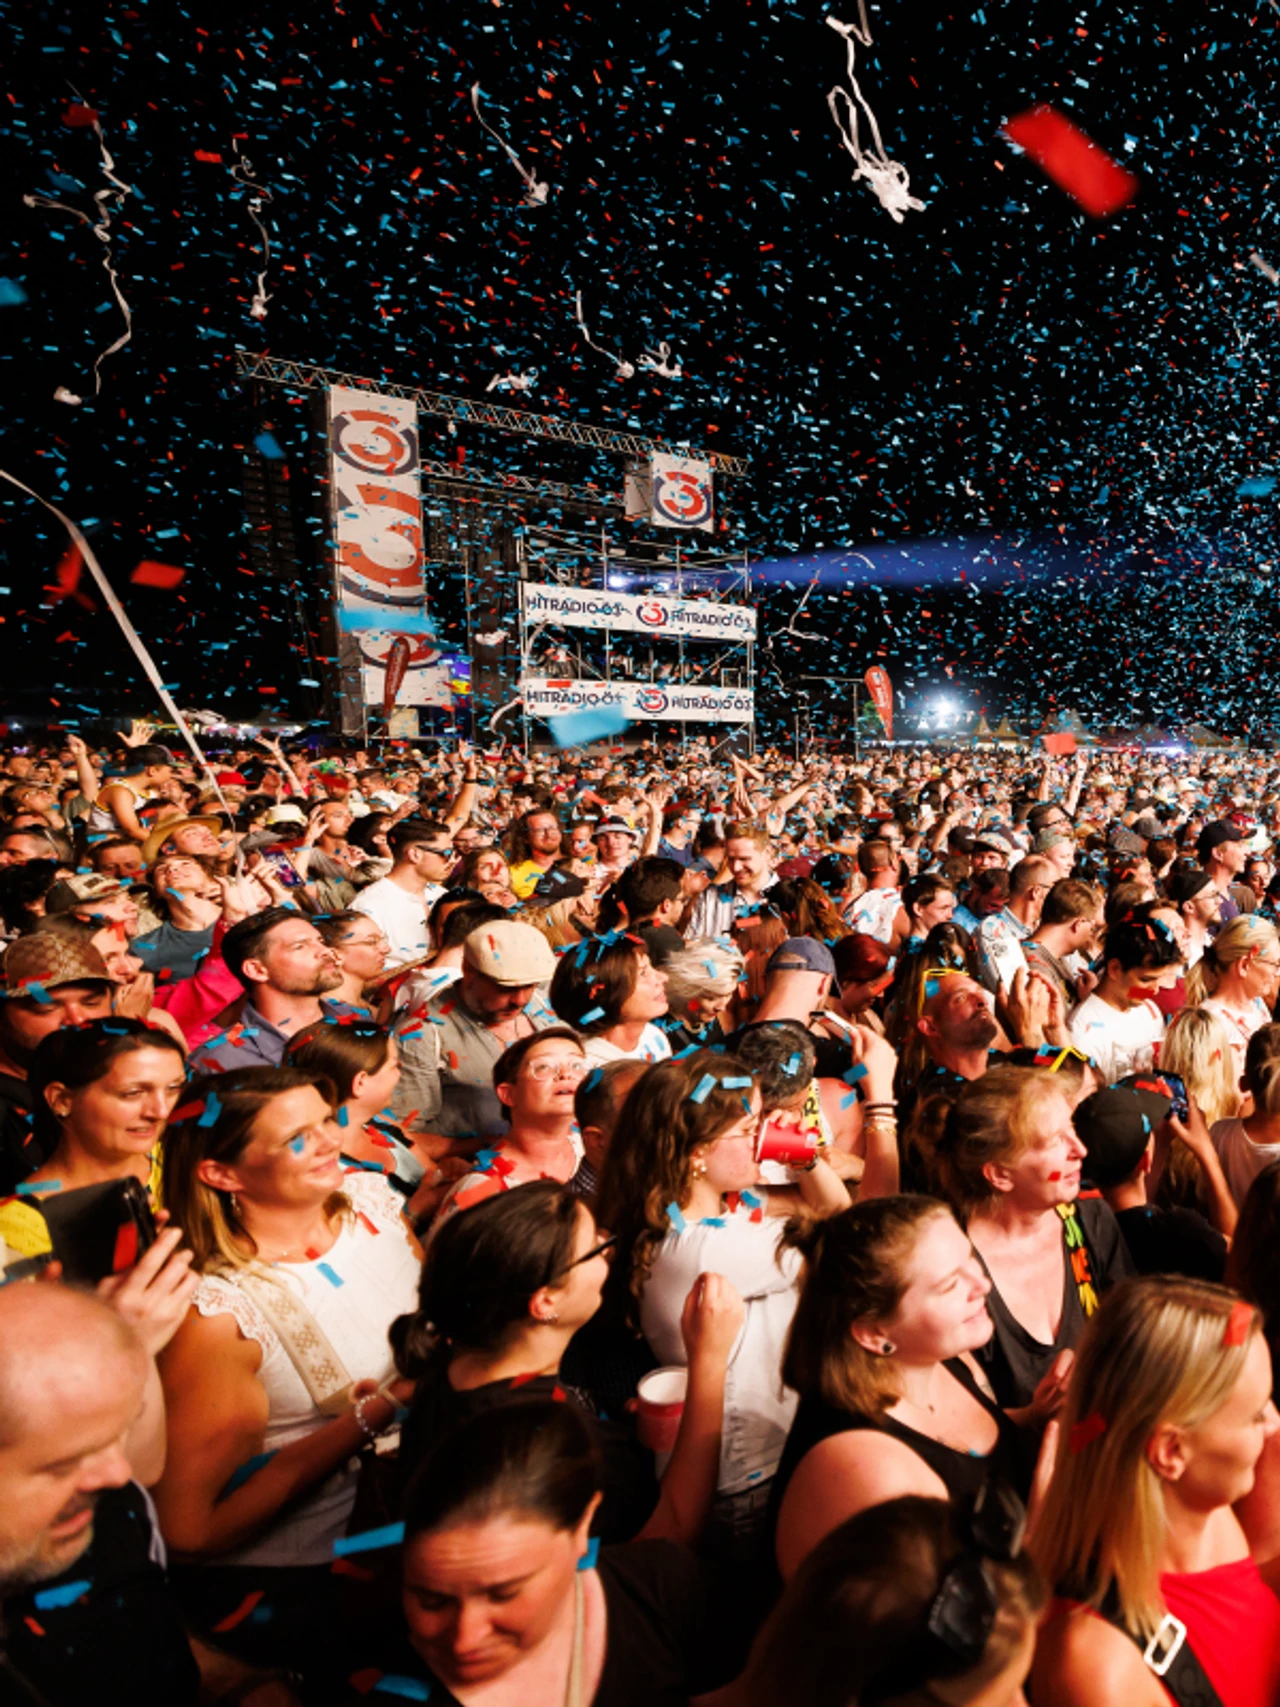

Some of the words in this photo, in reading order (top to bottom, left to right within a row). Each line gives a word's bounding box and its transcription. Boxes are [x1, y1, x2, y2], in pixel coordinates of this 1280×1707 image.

[526, 596, 597, 614] HITRADIO
[671, 610, 731, 627] HITRADIO
[527, 689, 599, 706] HITRADIO
